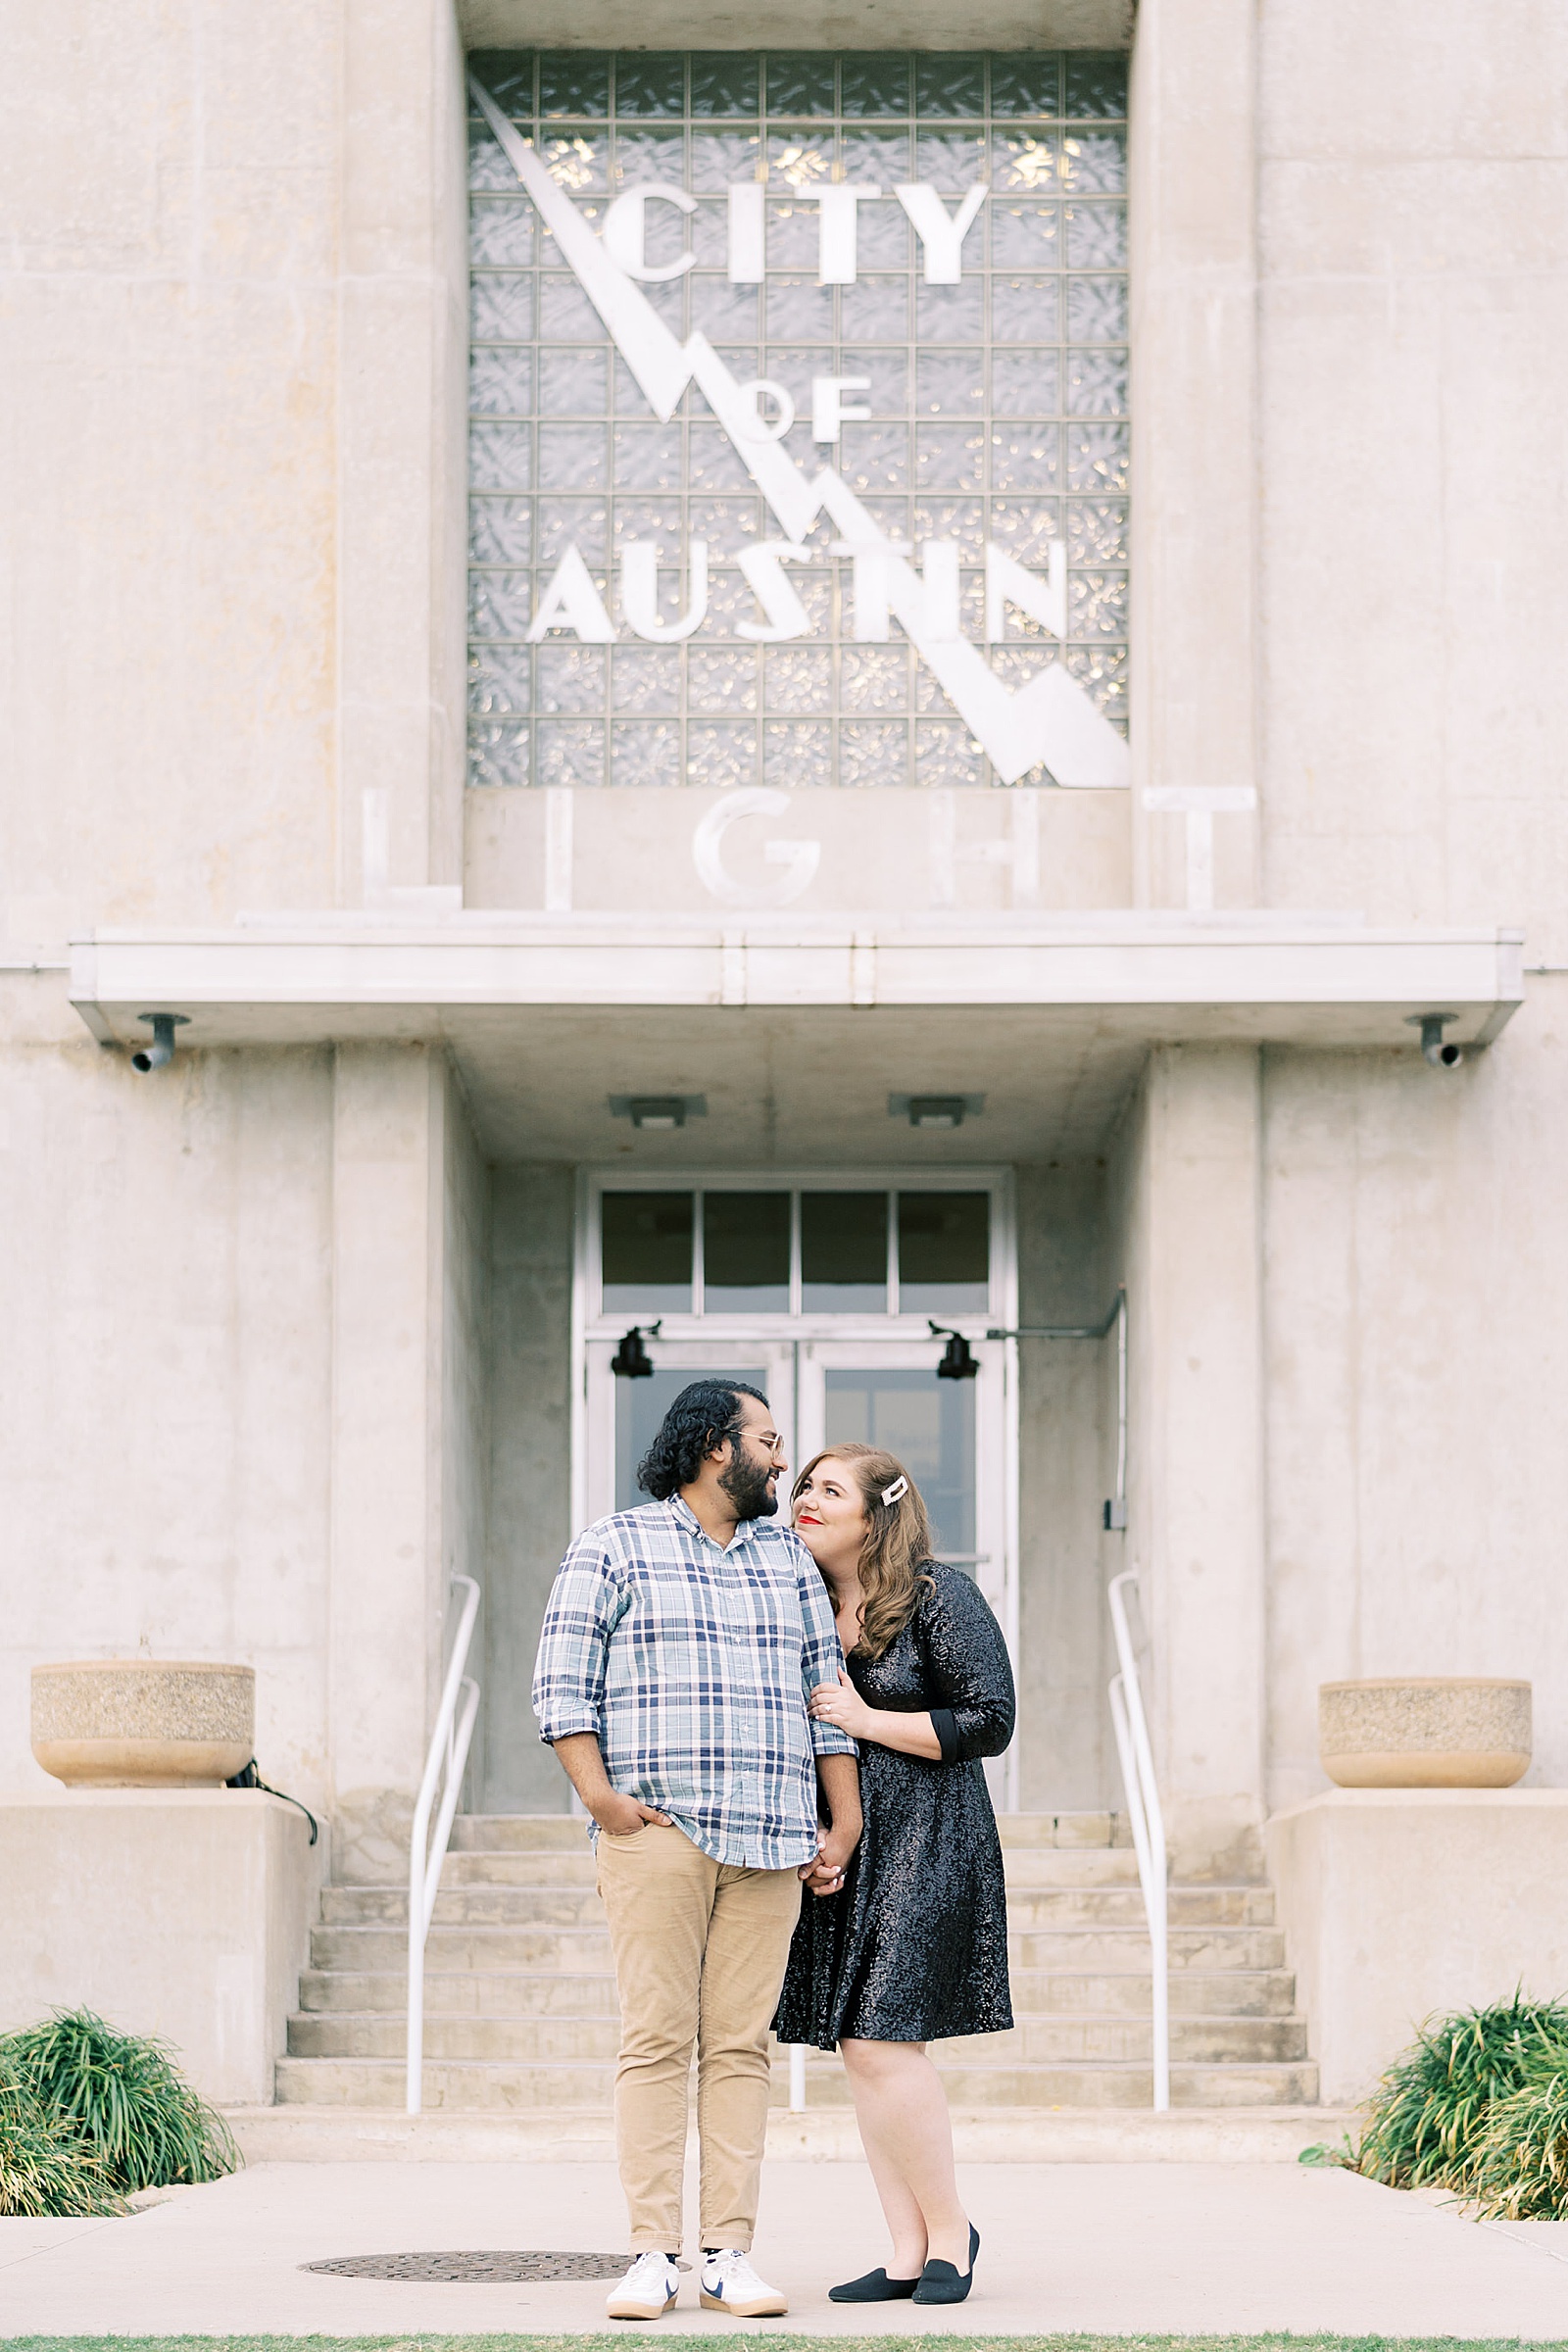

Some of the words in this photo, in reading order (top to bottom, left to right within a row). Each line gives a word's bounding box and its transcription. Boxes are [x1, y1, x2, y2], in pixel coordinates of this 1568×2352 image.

[602, 183, 989, 284] CITY
[736, 377, 871, 443] OF
[526, 540, 1065, 643] AUSTIN
[362, 787, 1257, 910] LIGHT
